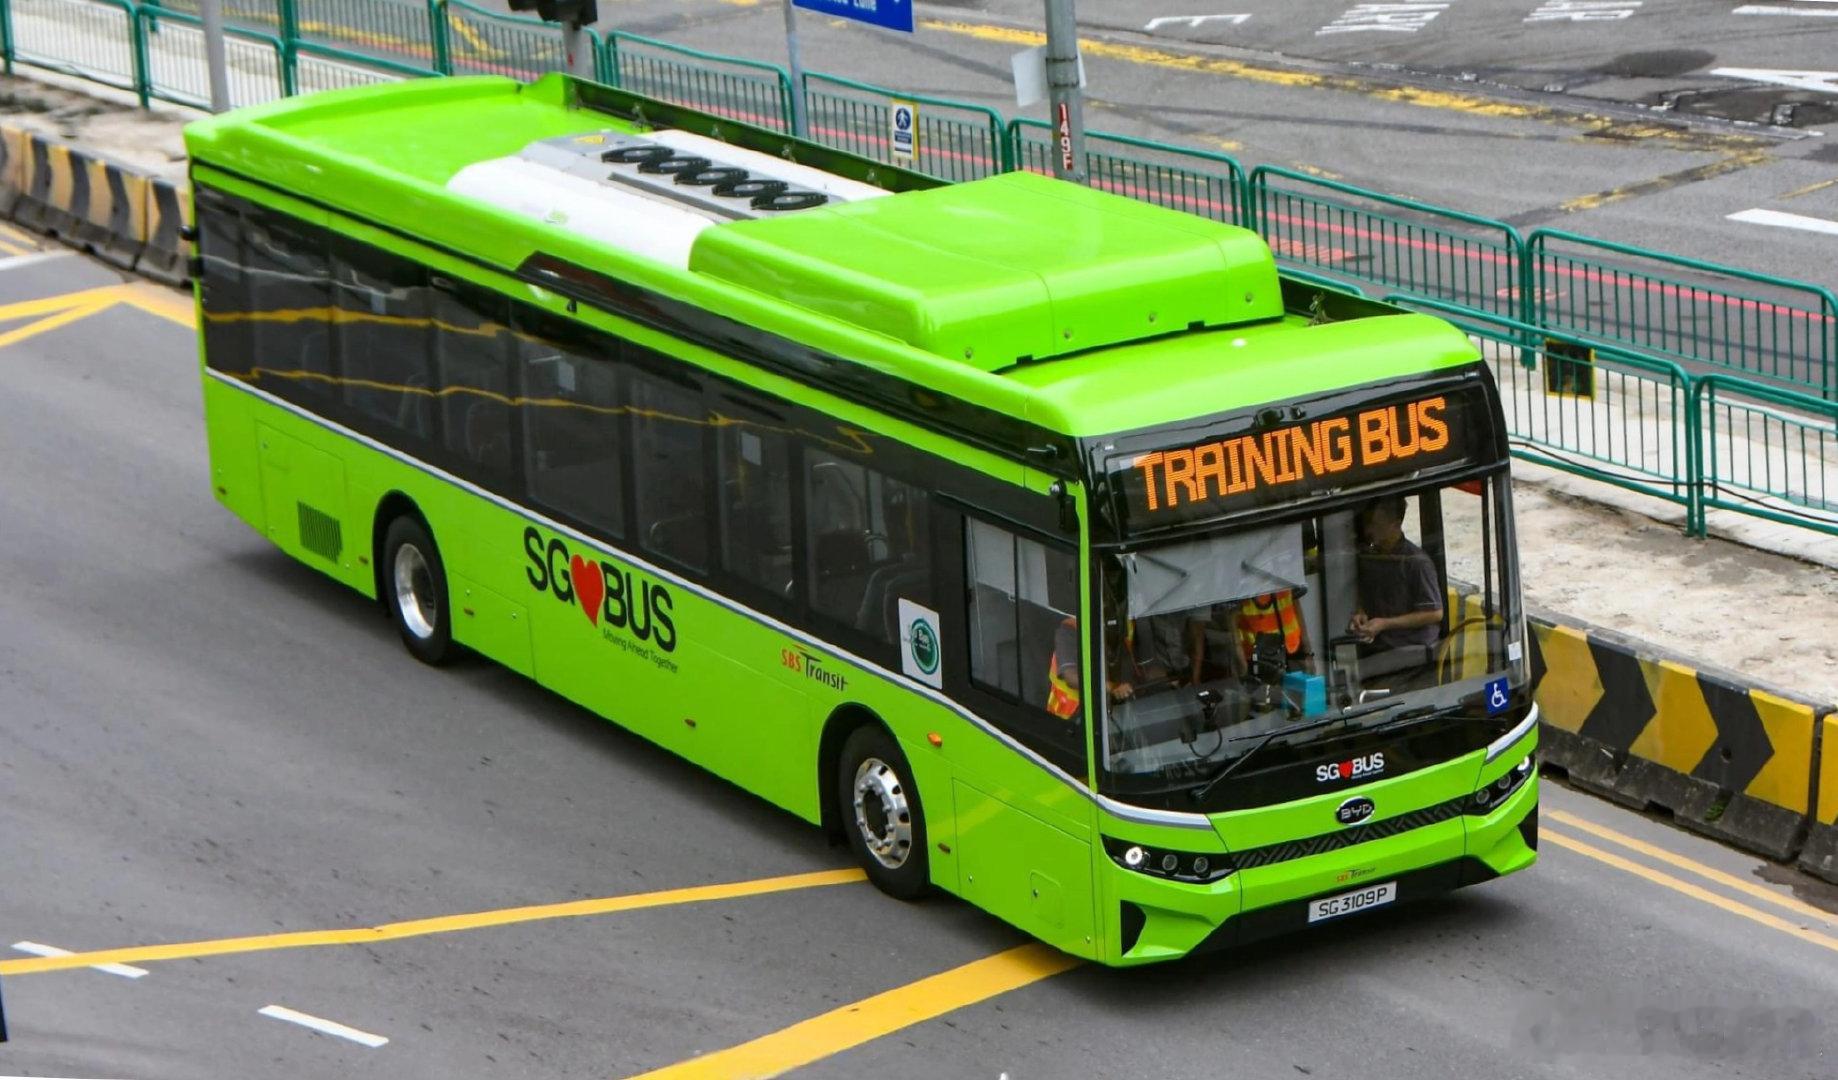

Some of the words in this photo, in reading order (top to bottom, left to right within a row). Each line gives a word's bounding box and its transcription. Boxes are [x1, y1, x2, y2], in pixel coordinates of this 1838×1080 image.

[1133, 417, 1353, 511] TRAINING
[1358, 396, 1449, 467] BUS
[600, 560, 677, 653] BUS
[781, 648, 801, 673] SBS
[799, 651, 849, 692] Transit
[1352, 752, 1385, 775] BUS
[1340, 803, 1373, 820] BYD
